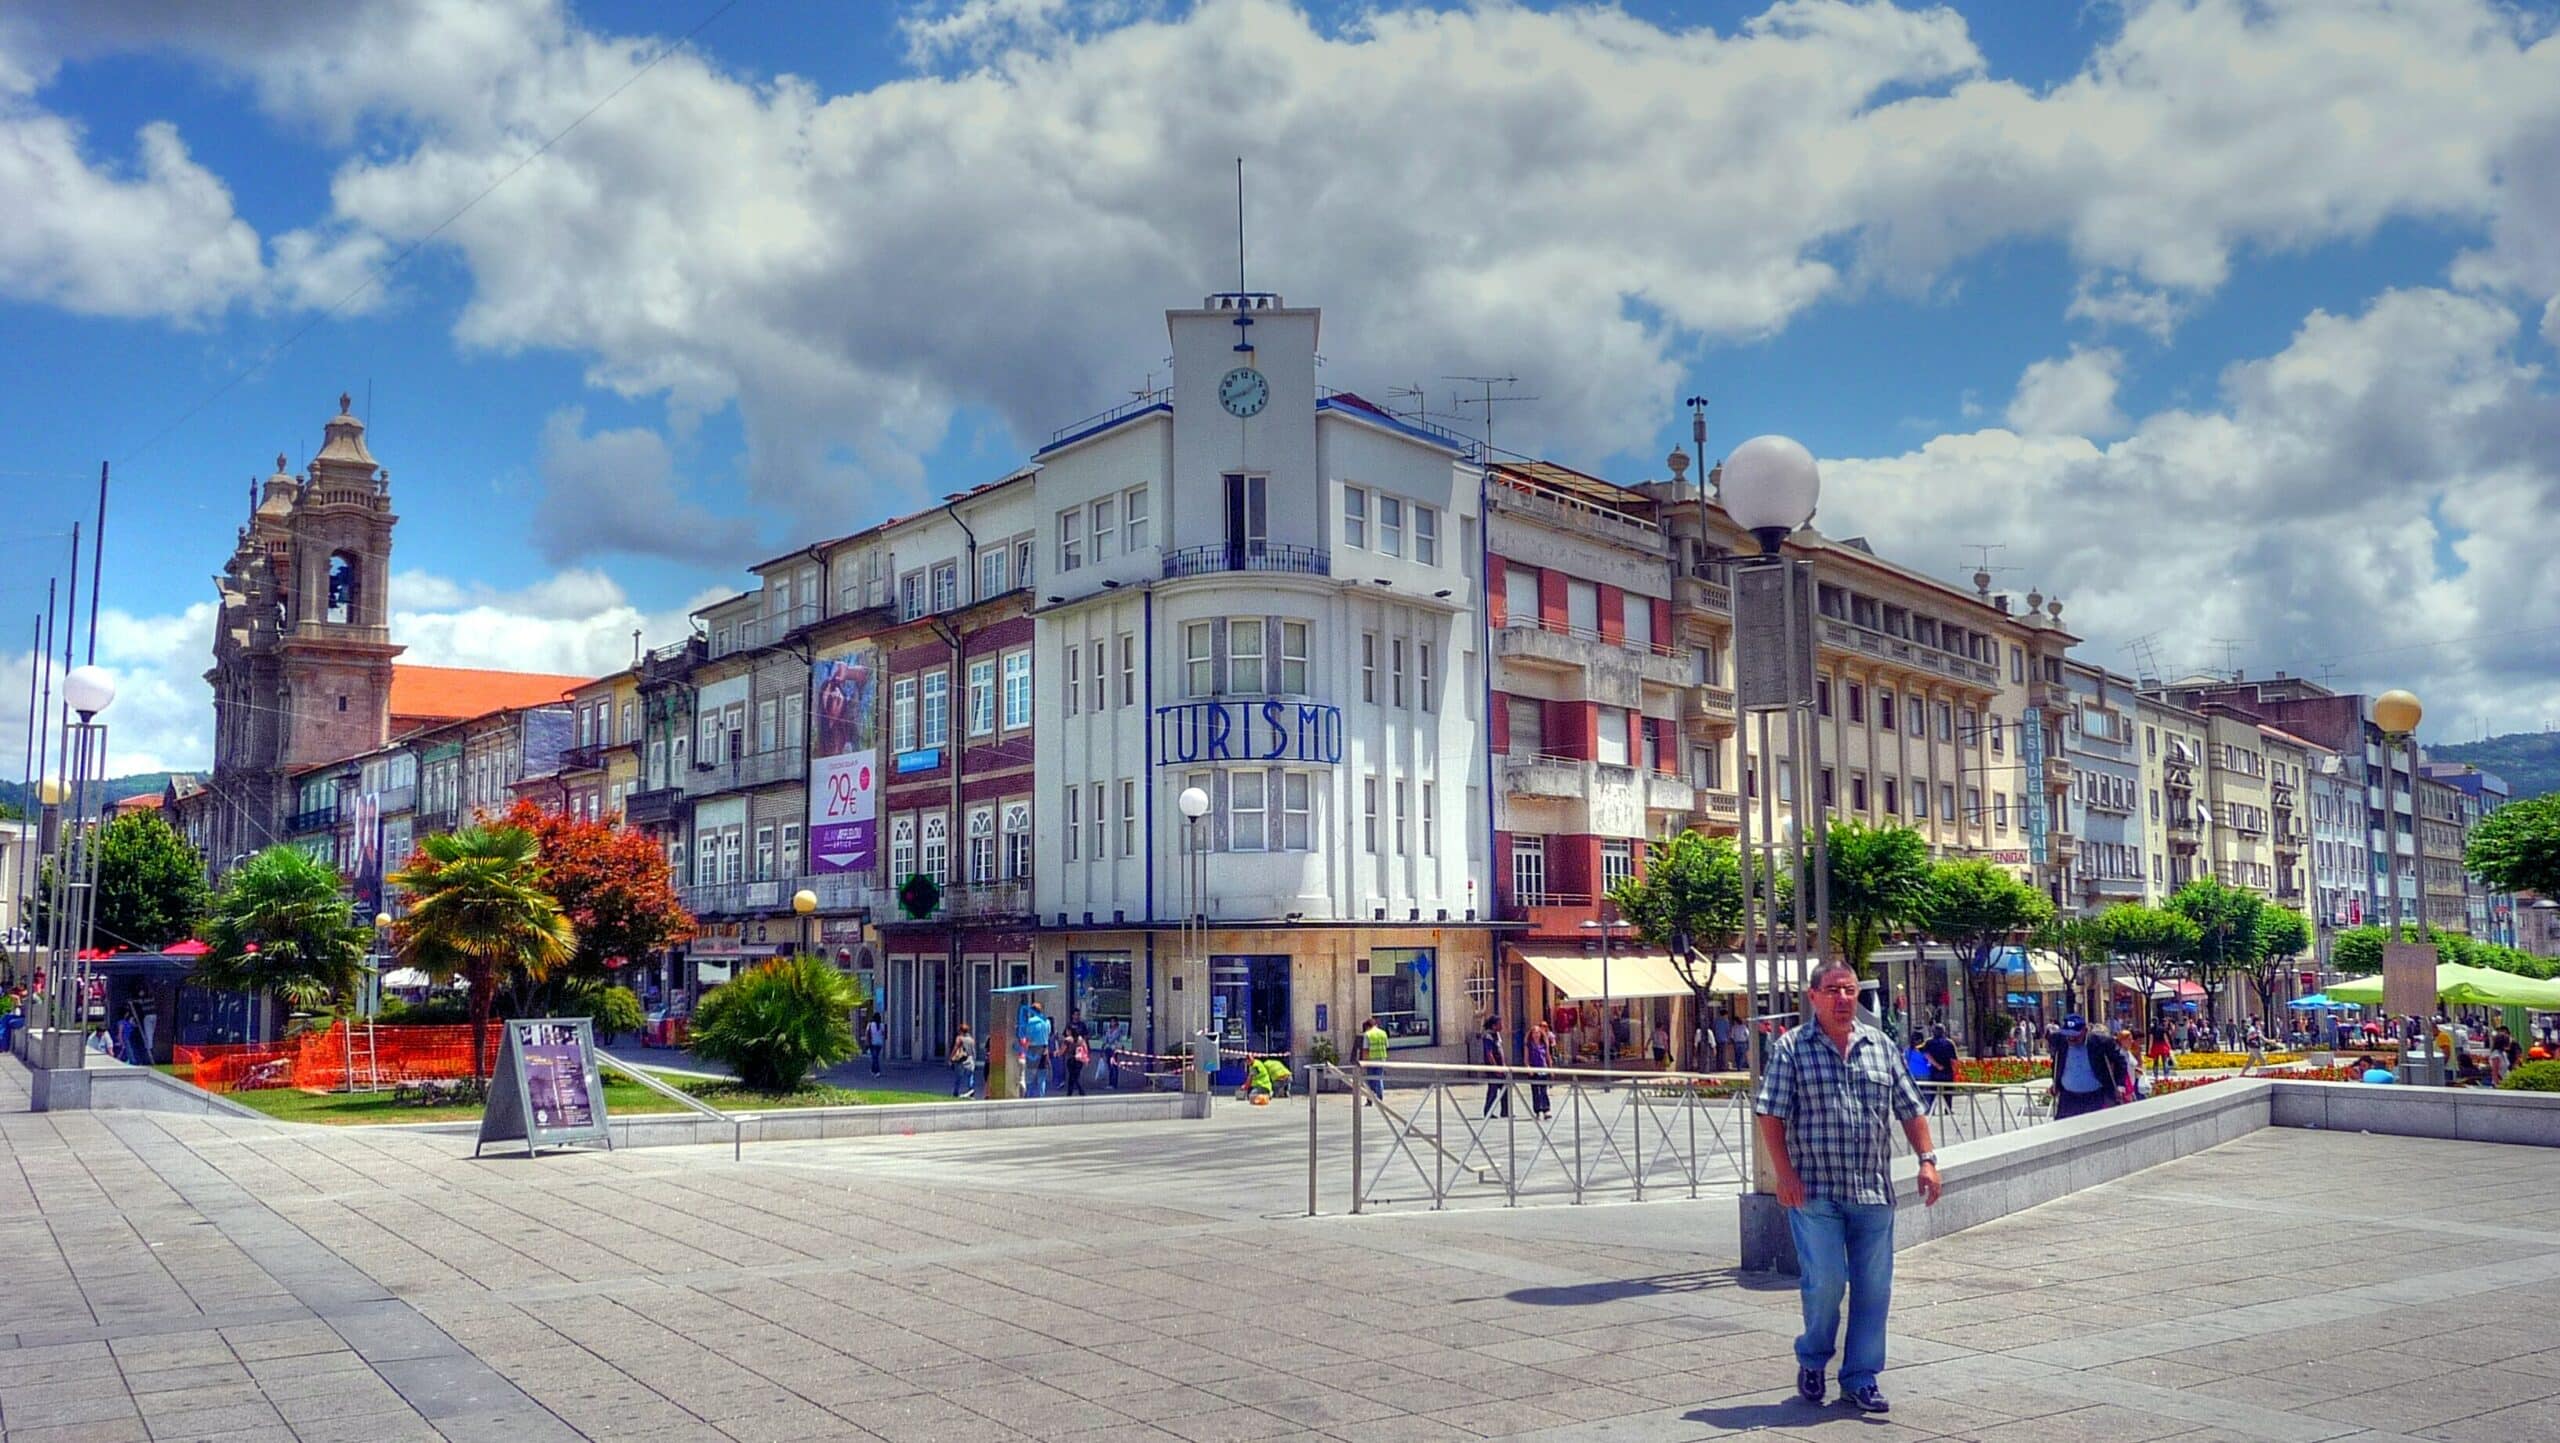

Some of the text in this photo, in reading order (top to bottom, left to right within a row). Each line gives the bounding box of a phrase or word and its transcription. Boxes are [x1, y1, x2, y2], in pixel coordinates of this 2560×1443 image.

[1155, 699, 1342, 766] TURISMO
[827, 772, 857, 816] 29€
[2025, 710, 2041, 863] RESIDENCIAL
